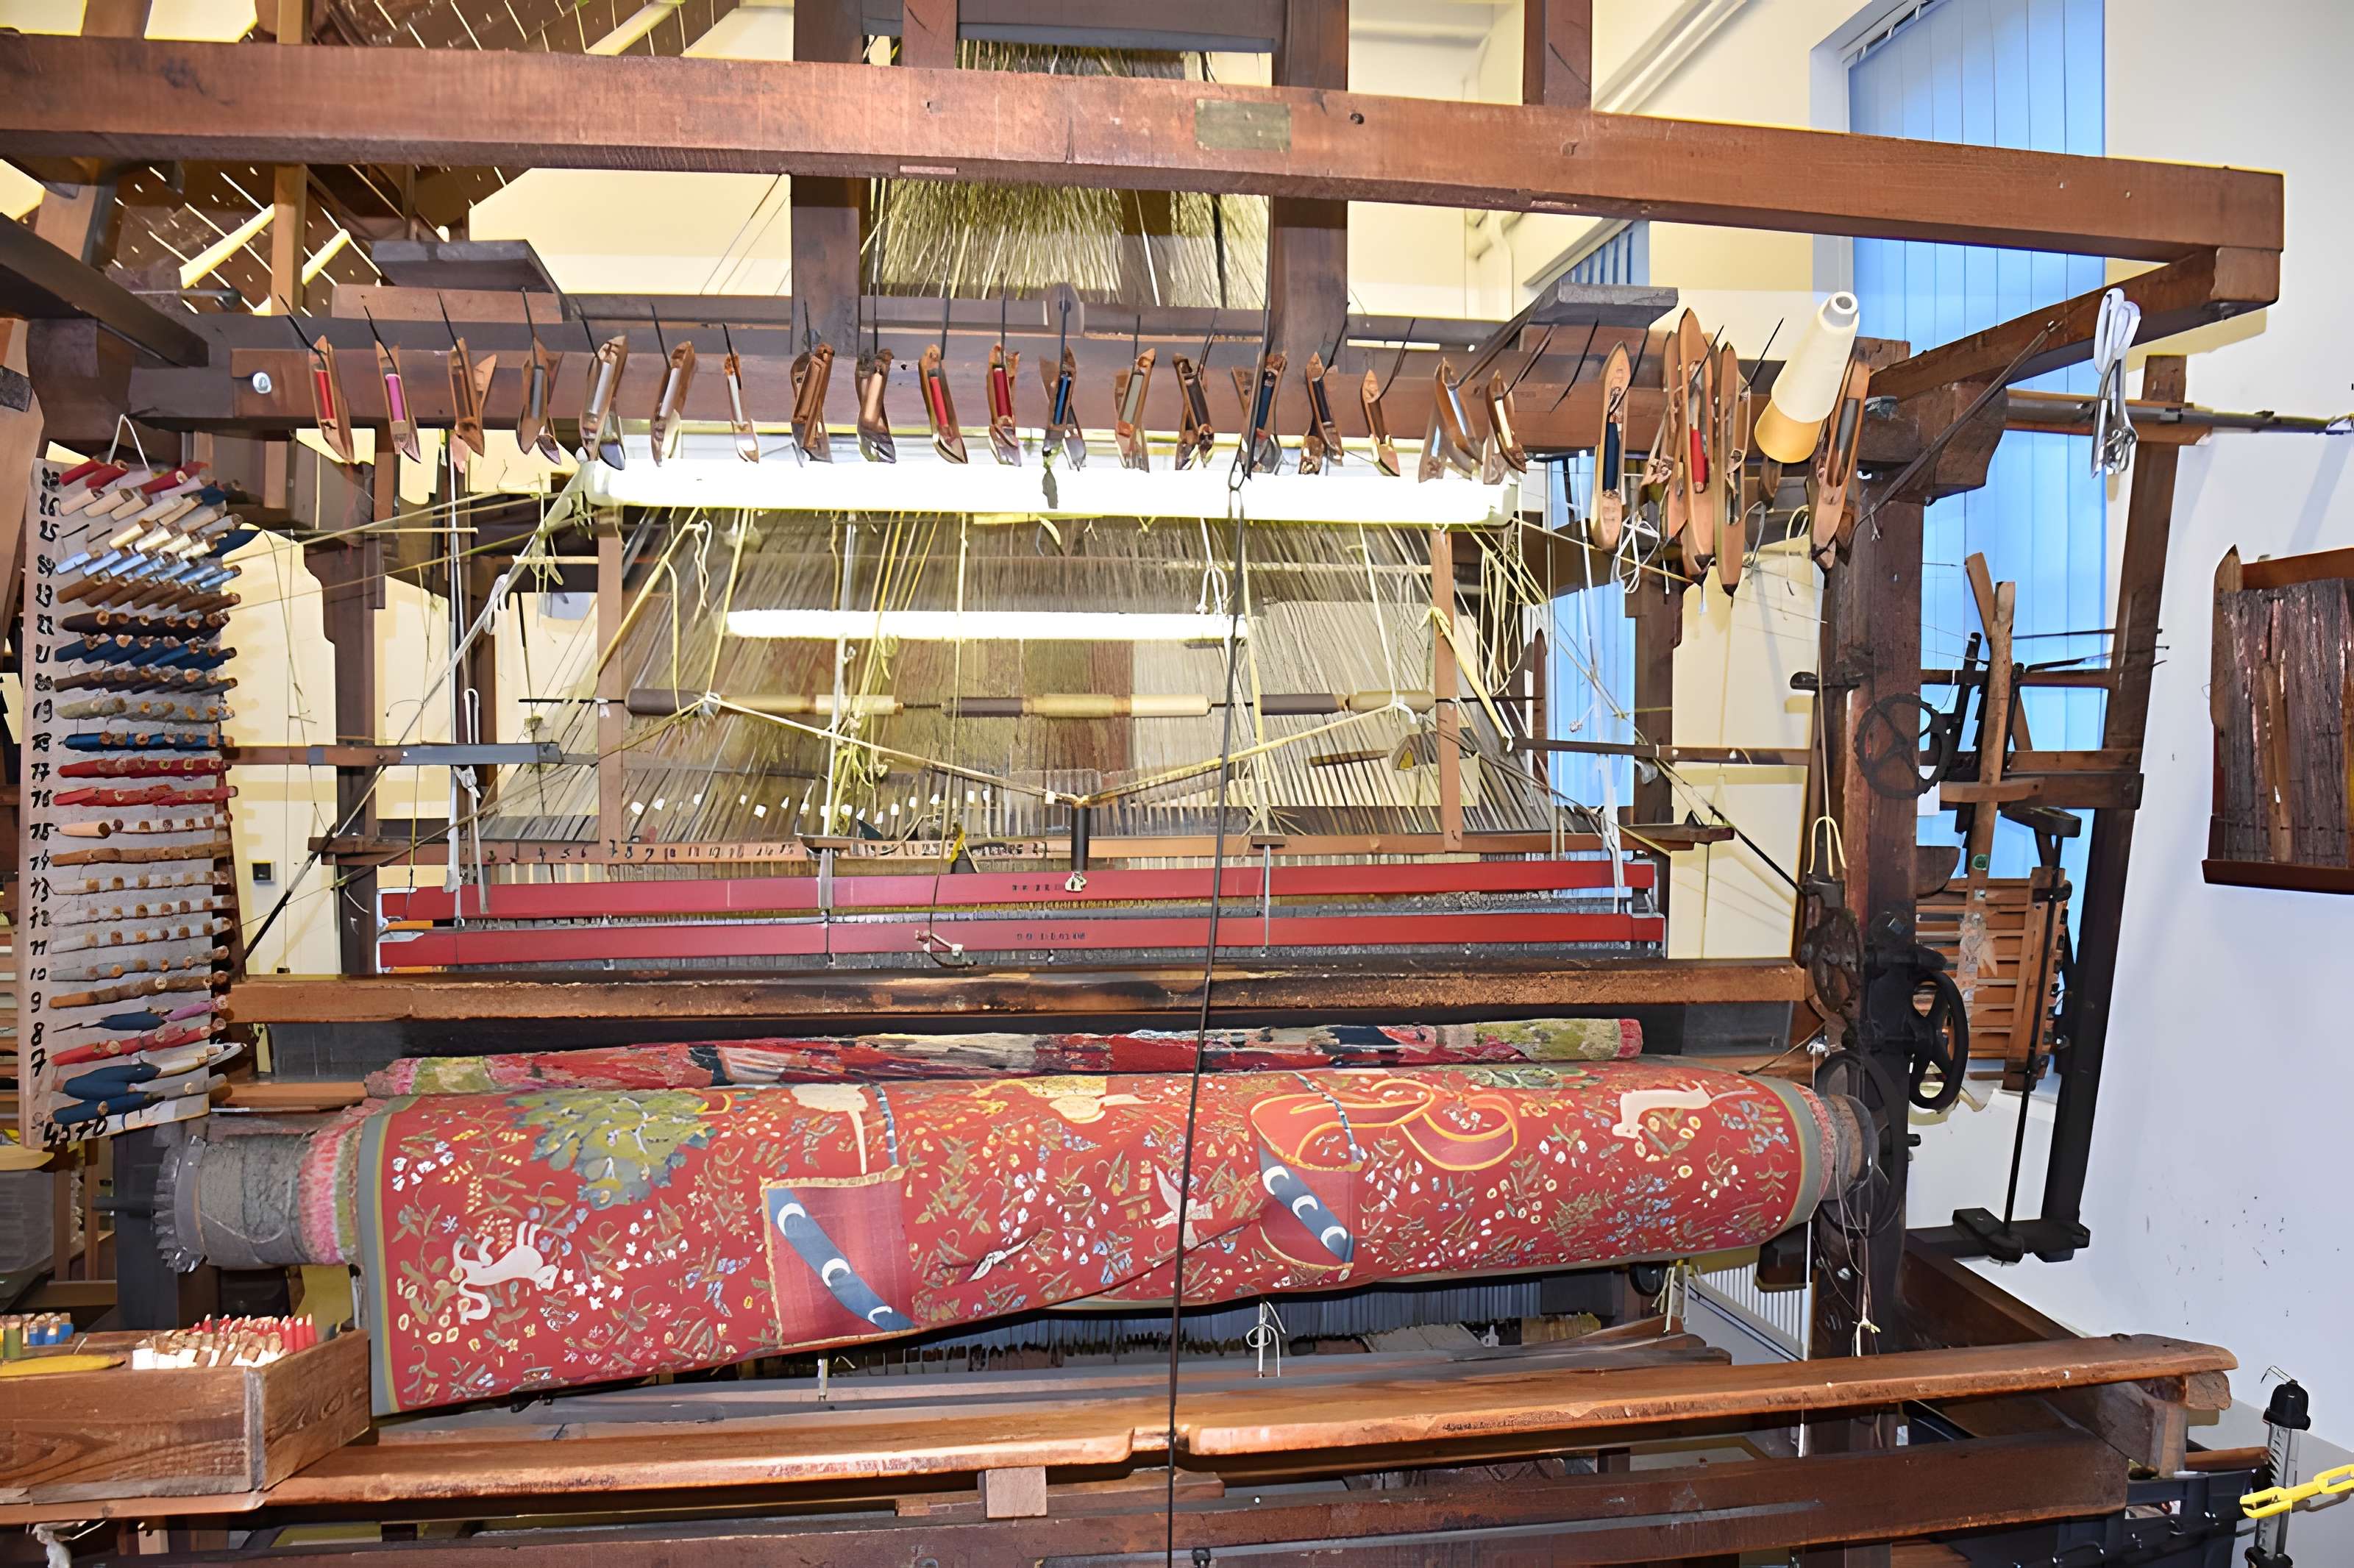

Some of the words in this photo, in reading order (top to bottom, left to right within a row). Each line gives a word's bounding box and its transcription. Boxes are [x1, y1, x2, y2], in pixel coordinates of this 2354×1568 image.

[30, 968, 46, 980] 10
[31, 991, 42, 1013] 9
[31, 1022, 44, 1047] 8
[31, 1048, 46, 1077] 7
